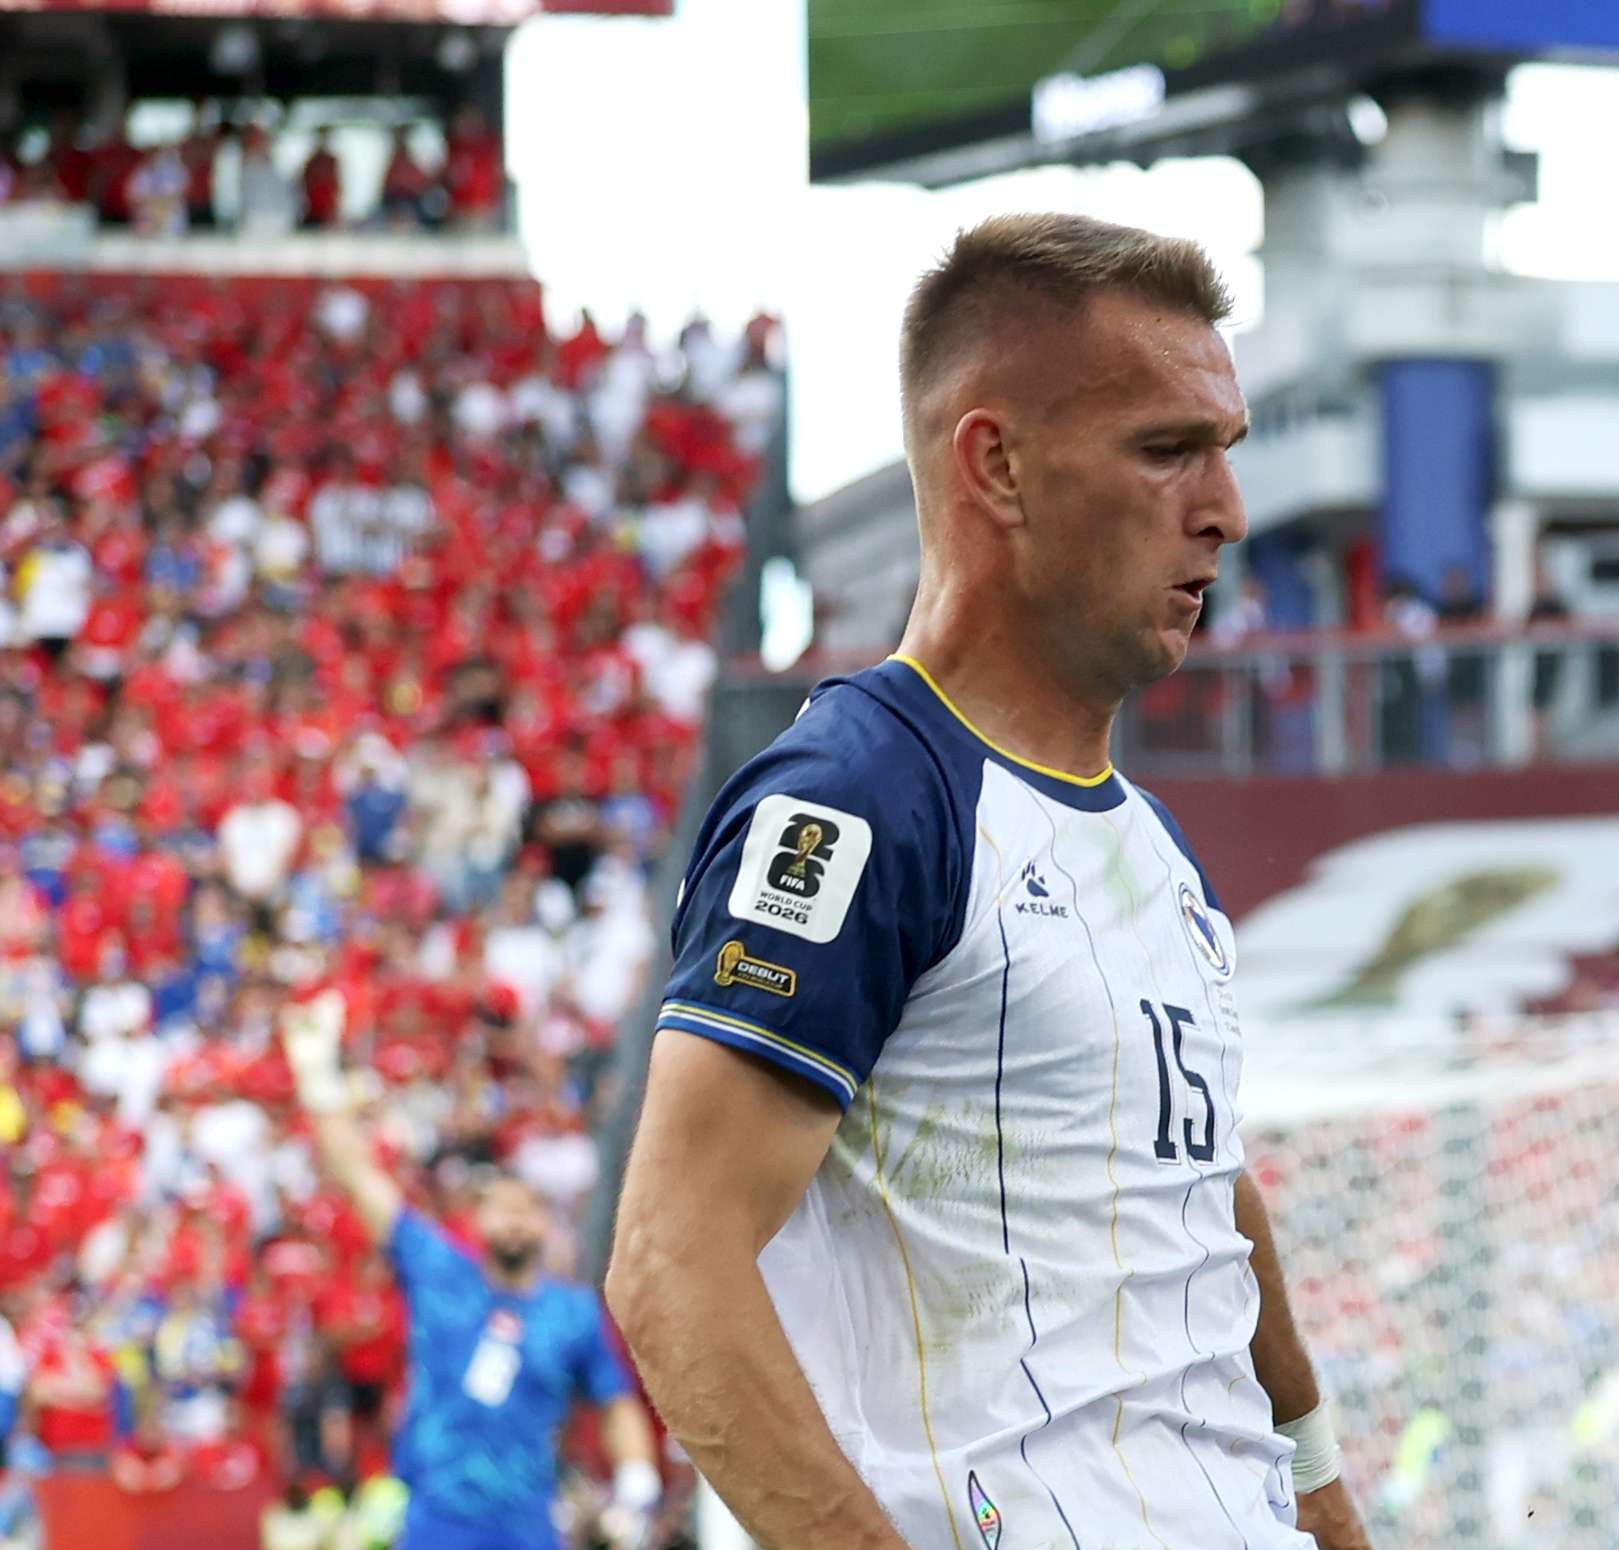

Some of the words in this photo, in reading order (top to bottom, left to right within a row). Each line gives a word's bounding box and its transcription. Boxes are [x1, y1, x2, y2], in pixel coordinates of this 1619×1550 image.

[779, 874, 805, 891] FIFA
[754, 900, 808, 924] 2026
[760, 890, 792, 906] WORLD
[793, 899, 815, 912] CUP
[1016, 902, 1068, 918] KELME
[738, 962, 789, 984] DEBUT
[1140, 998, 1216, 1164] 15
